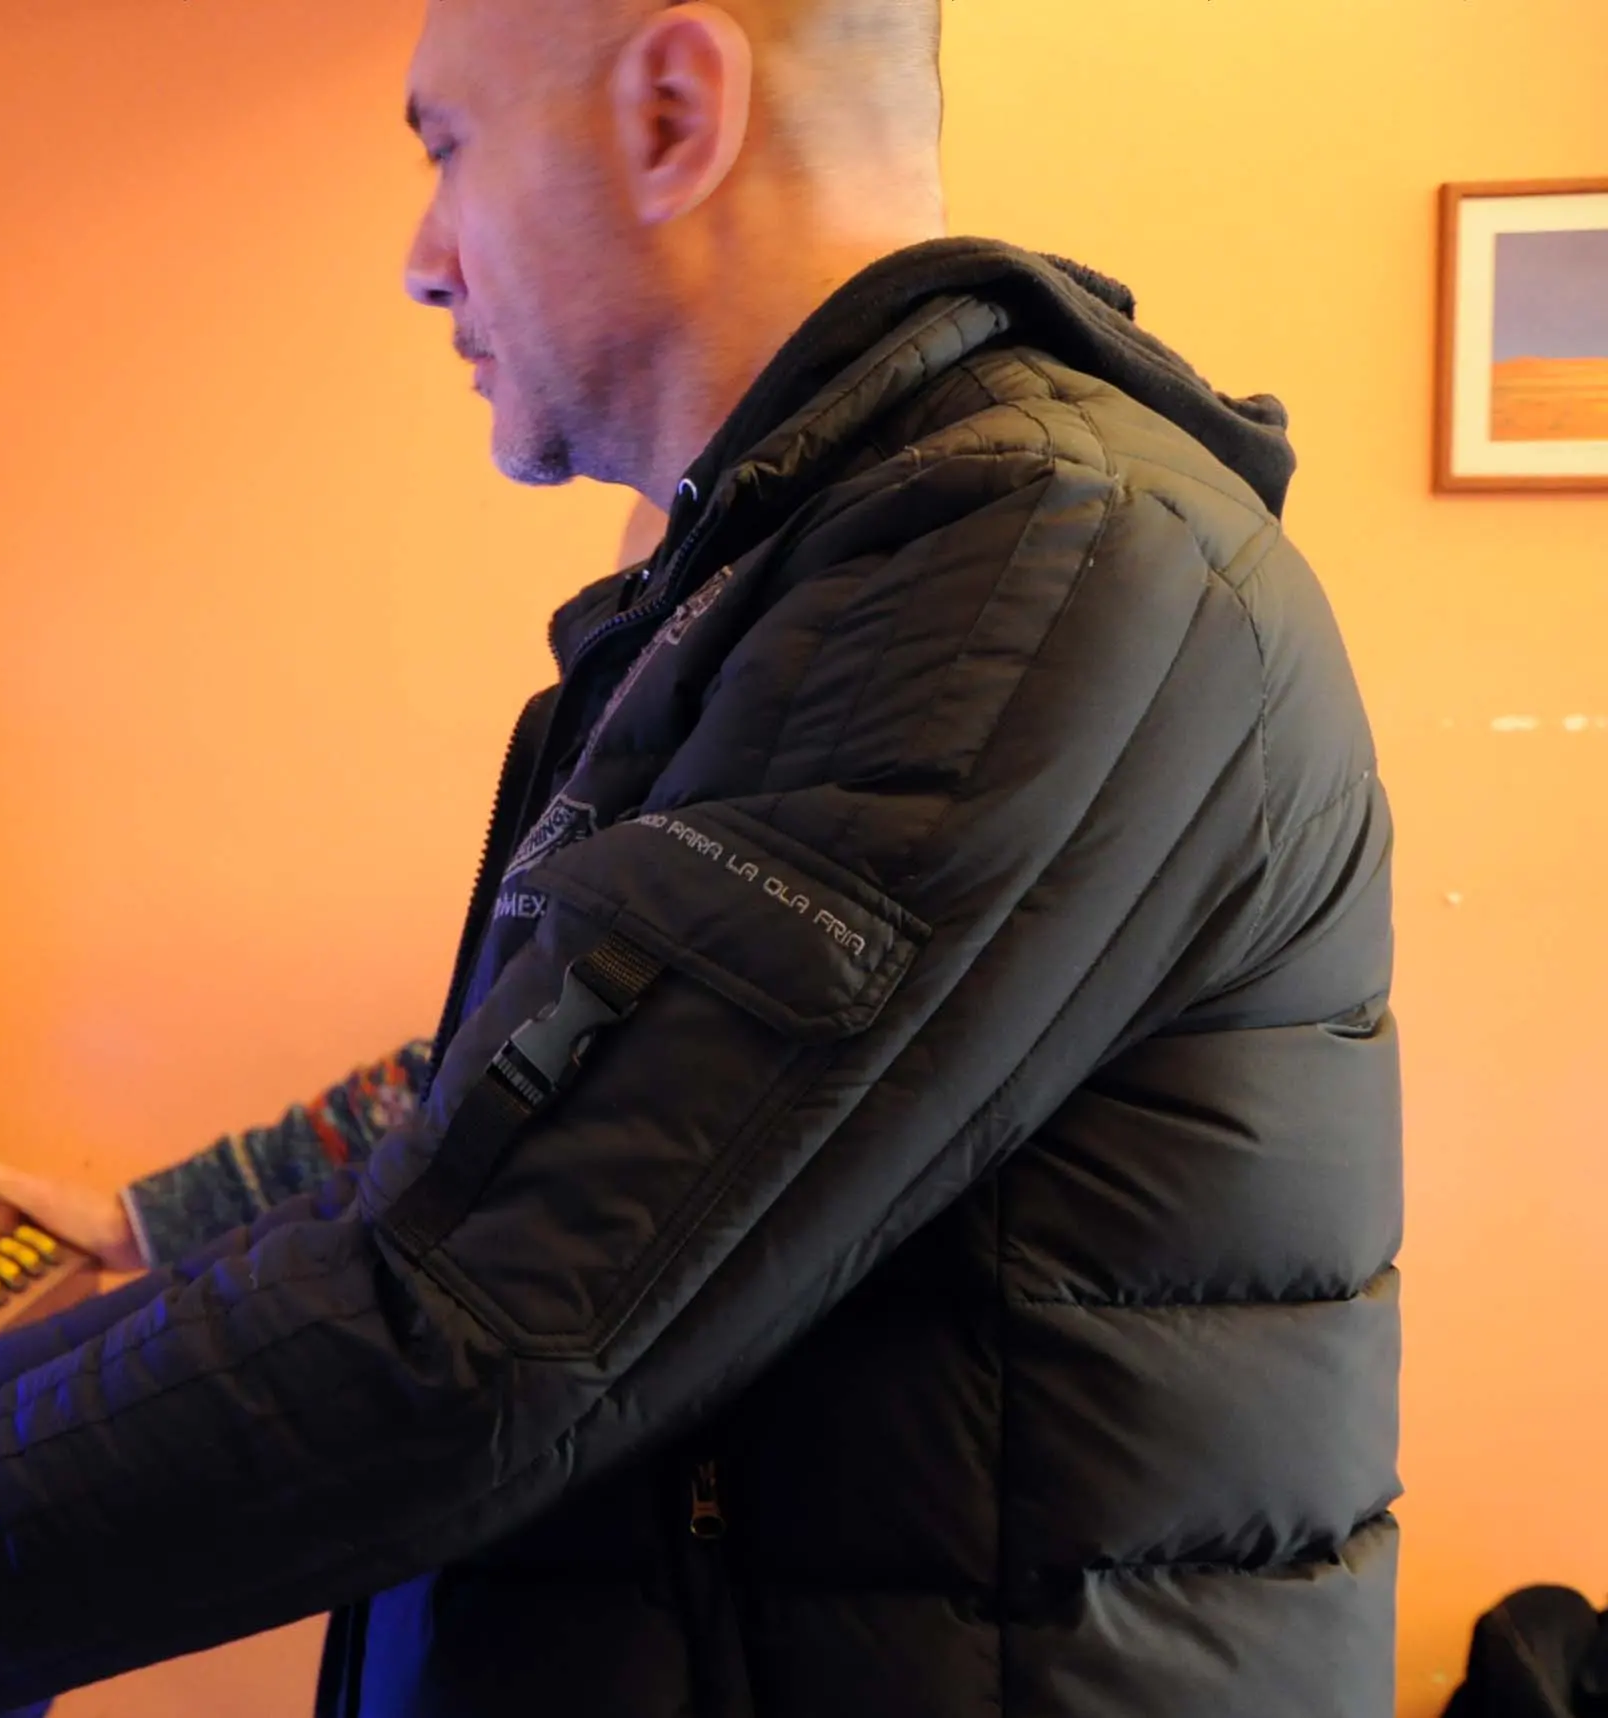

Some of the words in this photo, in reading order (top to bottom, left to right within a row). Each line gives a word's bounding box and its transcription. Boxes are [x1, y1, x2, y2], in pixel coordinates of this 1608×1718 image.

[666, 820, 724, 862] PARA
[726, 854, 760, 882] LA
[763, 876, 811, 914] OLA
[813, 908, 866, 956] FRIA
